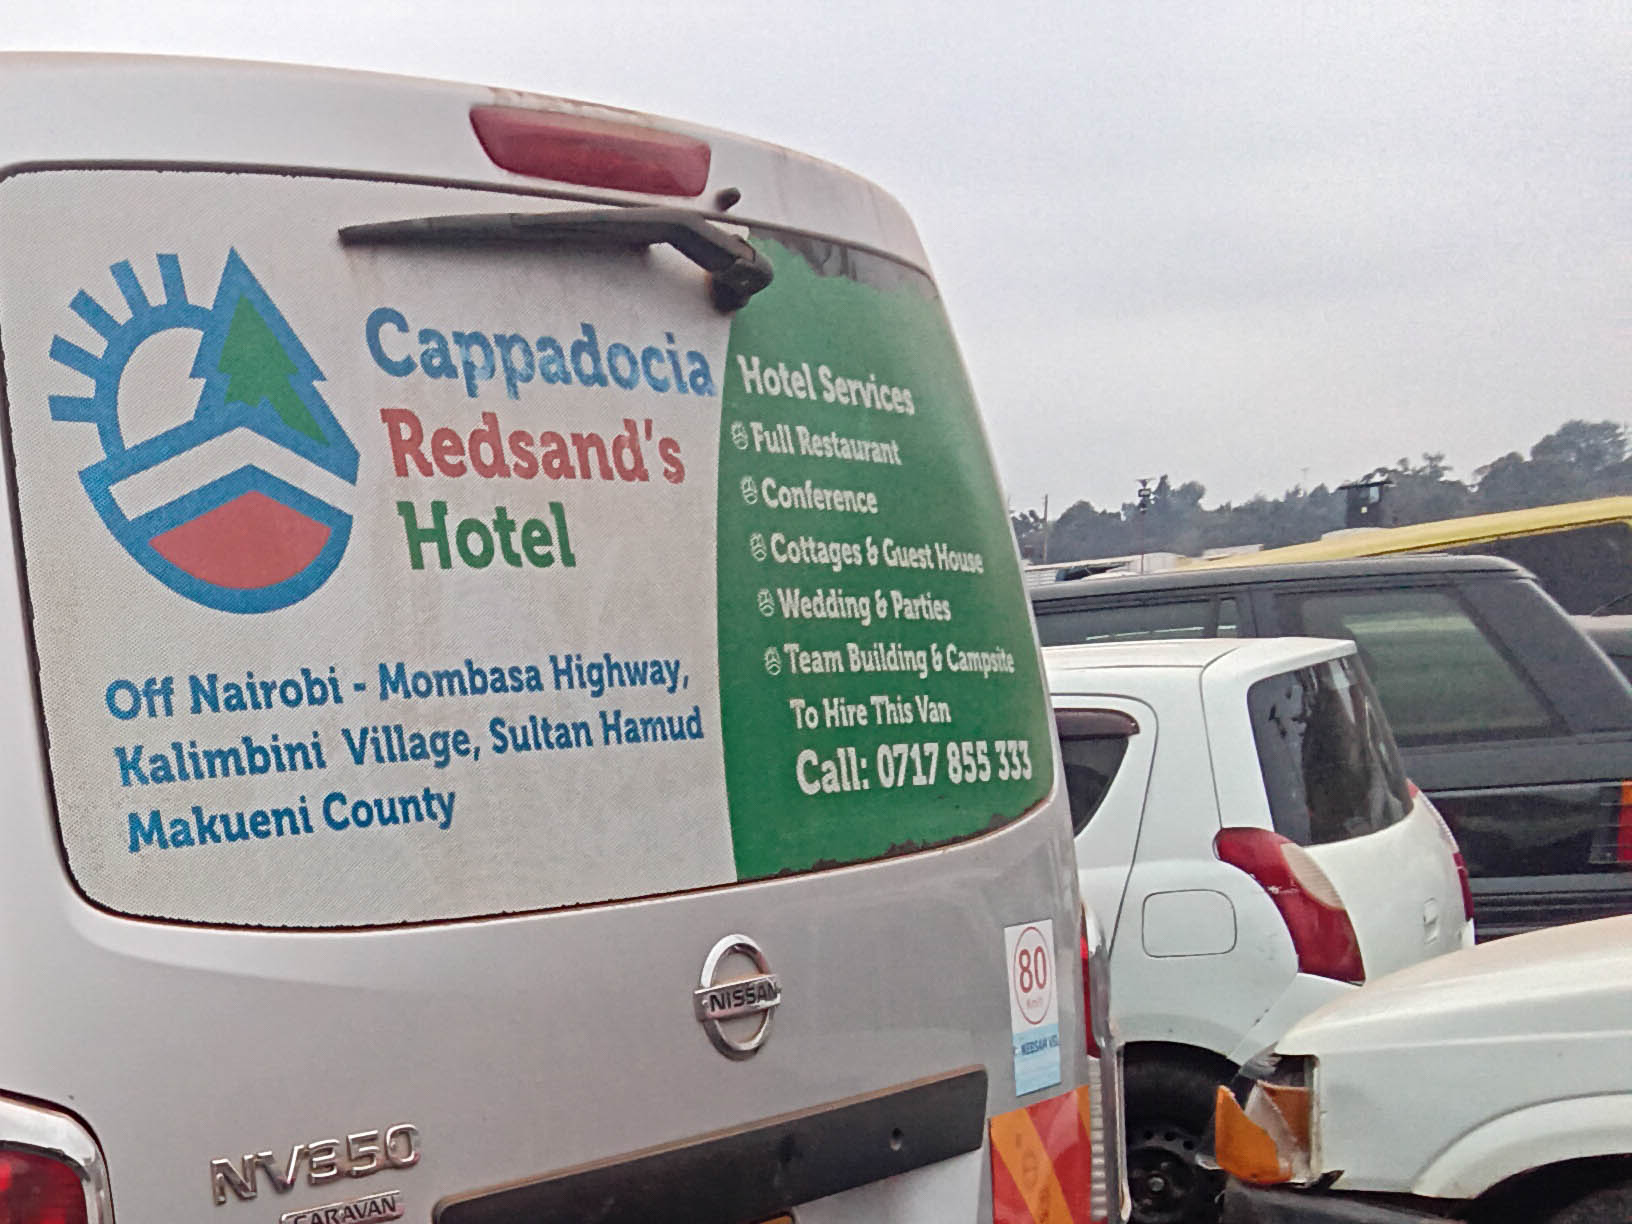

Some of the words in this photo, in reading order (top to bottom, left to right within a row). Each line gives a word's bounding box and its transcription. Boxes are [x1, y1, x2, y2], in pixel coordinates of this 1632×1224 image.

[366, 307, 718, 399] Cappadocia
[737, 355, 815, 401] Hotel
[820, 363, 915, 415] Services
[380, 408, 685, 484] Redsand's
[750, 422, 794, 454] Full
[797, 425, 902, 466] Restaurant
[761, 477, 878, 515] Conference
[397, 501, 576, 570] Hotel
[770, 533, 862, 572] Cottages
[866, 536, 878, 564] &
[882, 537, 934, 570] Guest
[935, 542, 984, 574] House
[776, 588, 871, 627] Wedding
[874, 590, 887, 619] &
[891, 590, 951, 621] Parties
[105, 677, 174, 721] Off
[190, 668, 343, 716] Nairobi
[378, 658, 543, 700] Mombasa
[550, 652, 690, 694] Highway,
[784, 643, 844, 674] Team
[847, 643, 928, 678] Building
[930, 644, 943, 672] &
[946, 645, 1015, 678] Campsite
[790, 699, 819, 729] To
[822, 698, 868, 728] Hire
[870, 695, 914, 725] This
[916, 695, 951, 724] Van
[113, 728, 327, 787] Kalimbini
[343, 722, 481, 768] Village,
[489, 713, 593, 754] Sultan
[600, 706, 703, 746] Hamud
[796, 747, 869, 795] Call:
[877, 742, 939, 788] 0717
[947, 741, 990, 784] 855
[994, 740, 1032, 781] 333
[126, 796, 313, 853] Makueni
[321, 787, 455, 832] County
[1019, 946, 1048, 993] 80
[209, 1122, 421, 1206] NV350
